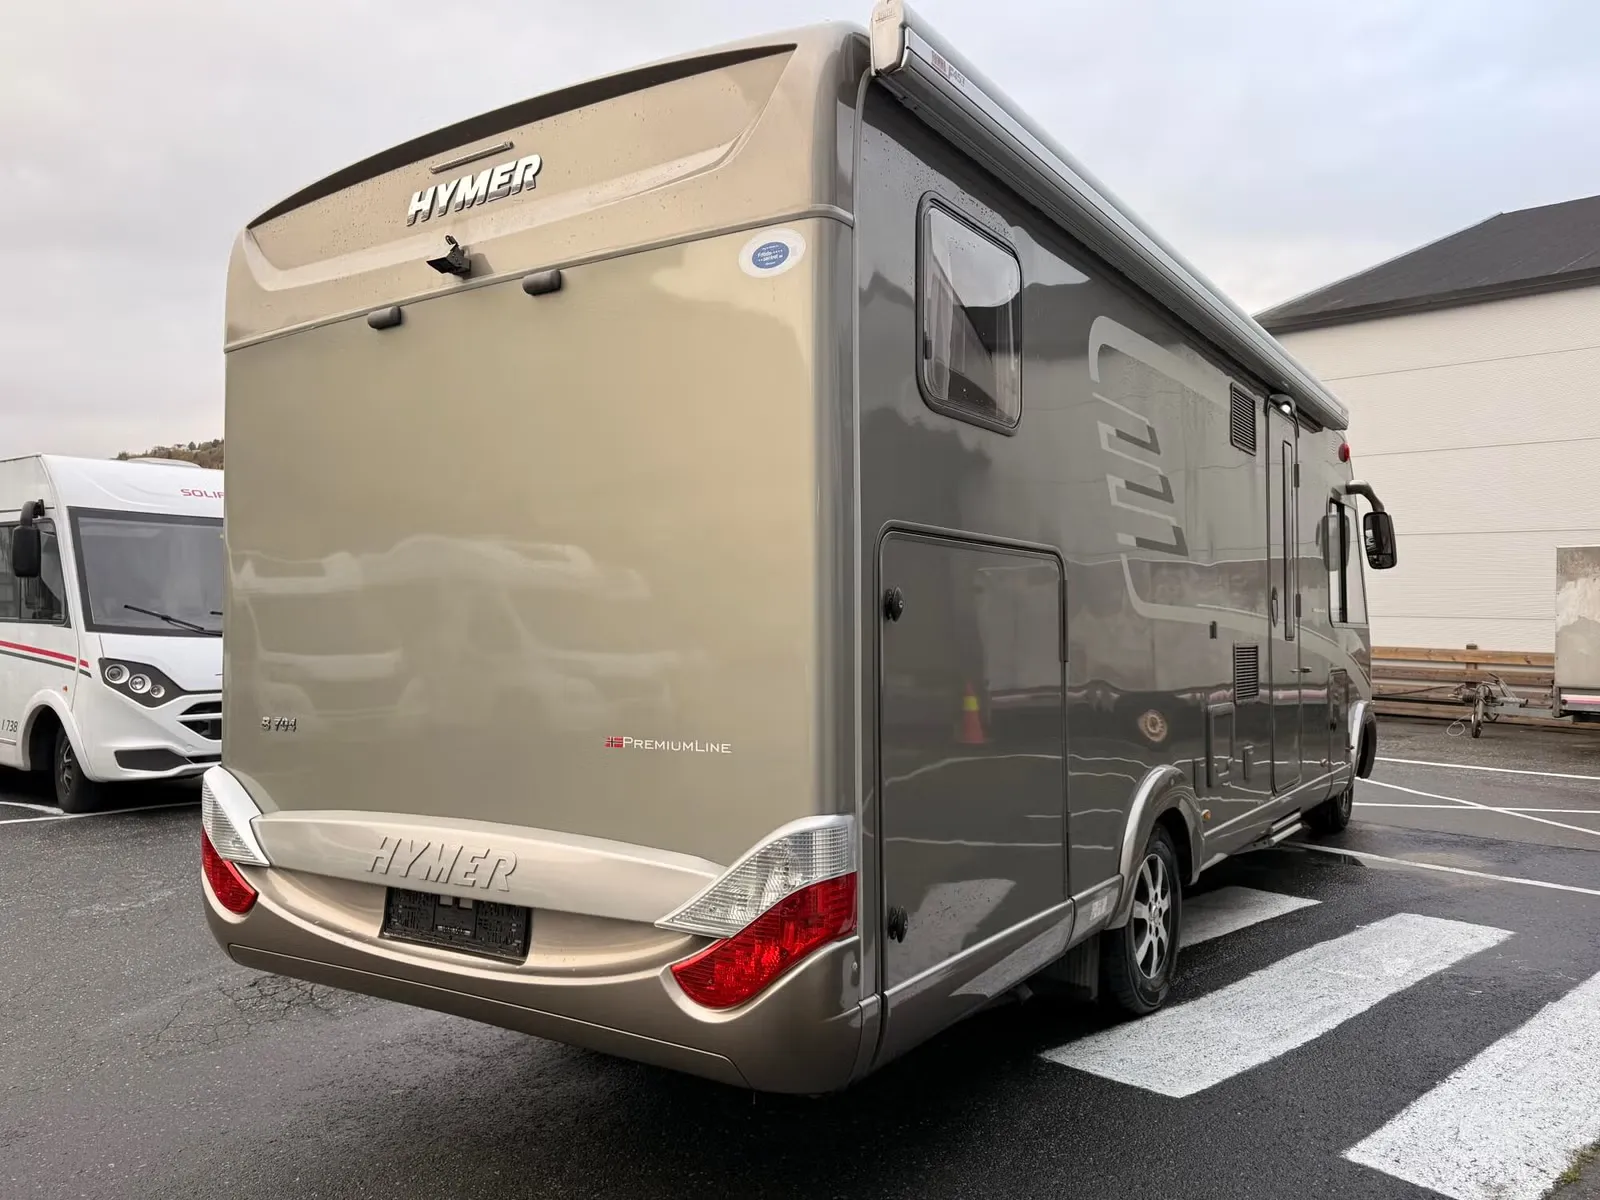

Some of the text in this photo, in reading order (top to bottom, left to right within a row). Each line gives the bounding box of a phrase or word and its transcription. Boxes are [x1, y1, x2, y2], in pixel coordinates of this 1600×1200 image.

[406, 153, 543, 227] HYMER
[6, 719, 19, 733] 738
[365, 836, 518, 893] HYMER
